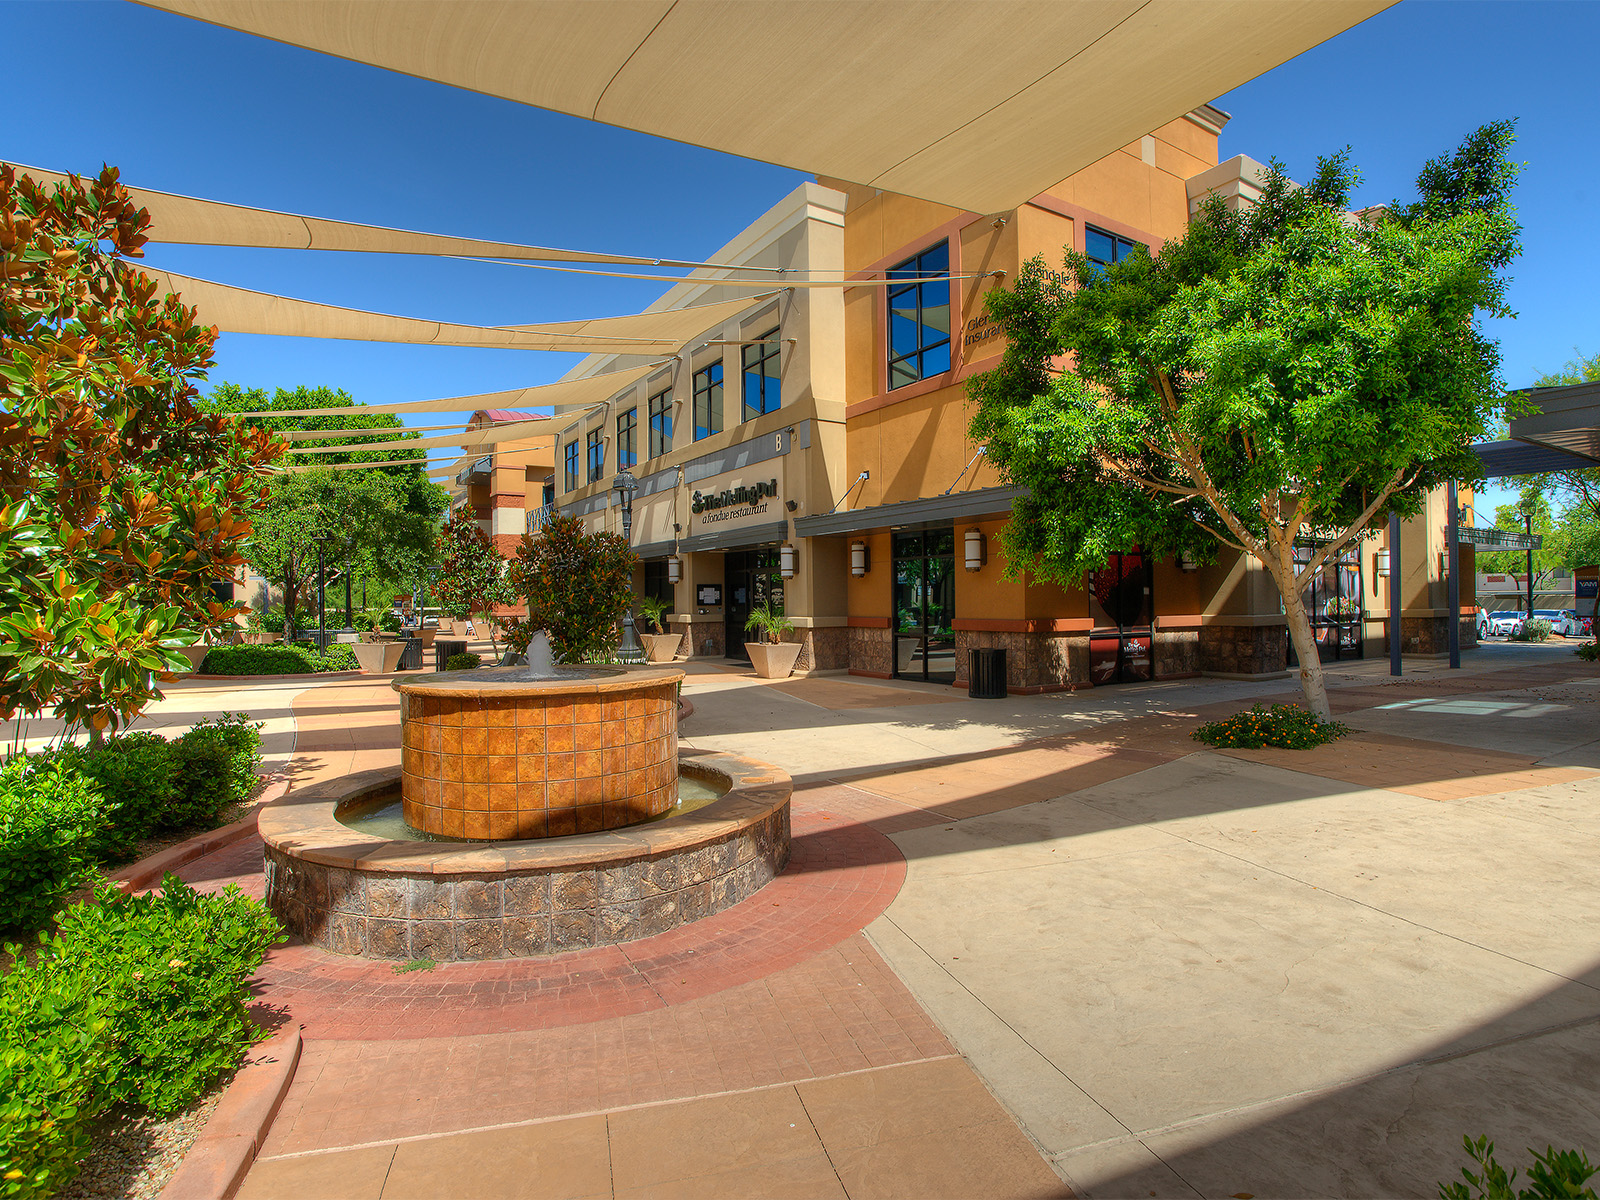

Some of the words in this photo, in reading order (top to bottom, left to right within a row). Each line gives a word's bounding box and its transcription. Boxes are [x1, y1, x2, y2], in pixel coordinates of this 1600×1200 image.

[775, 434, 782, 452] B
[703, 494, 720, 511] The
[720, 486, 758, 507] Melting
[757, 478, 777, 499] Pot
[706, 510, 730, 524] fondue
[730, 502, 768, 519] restaurant
